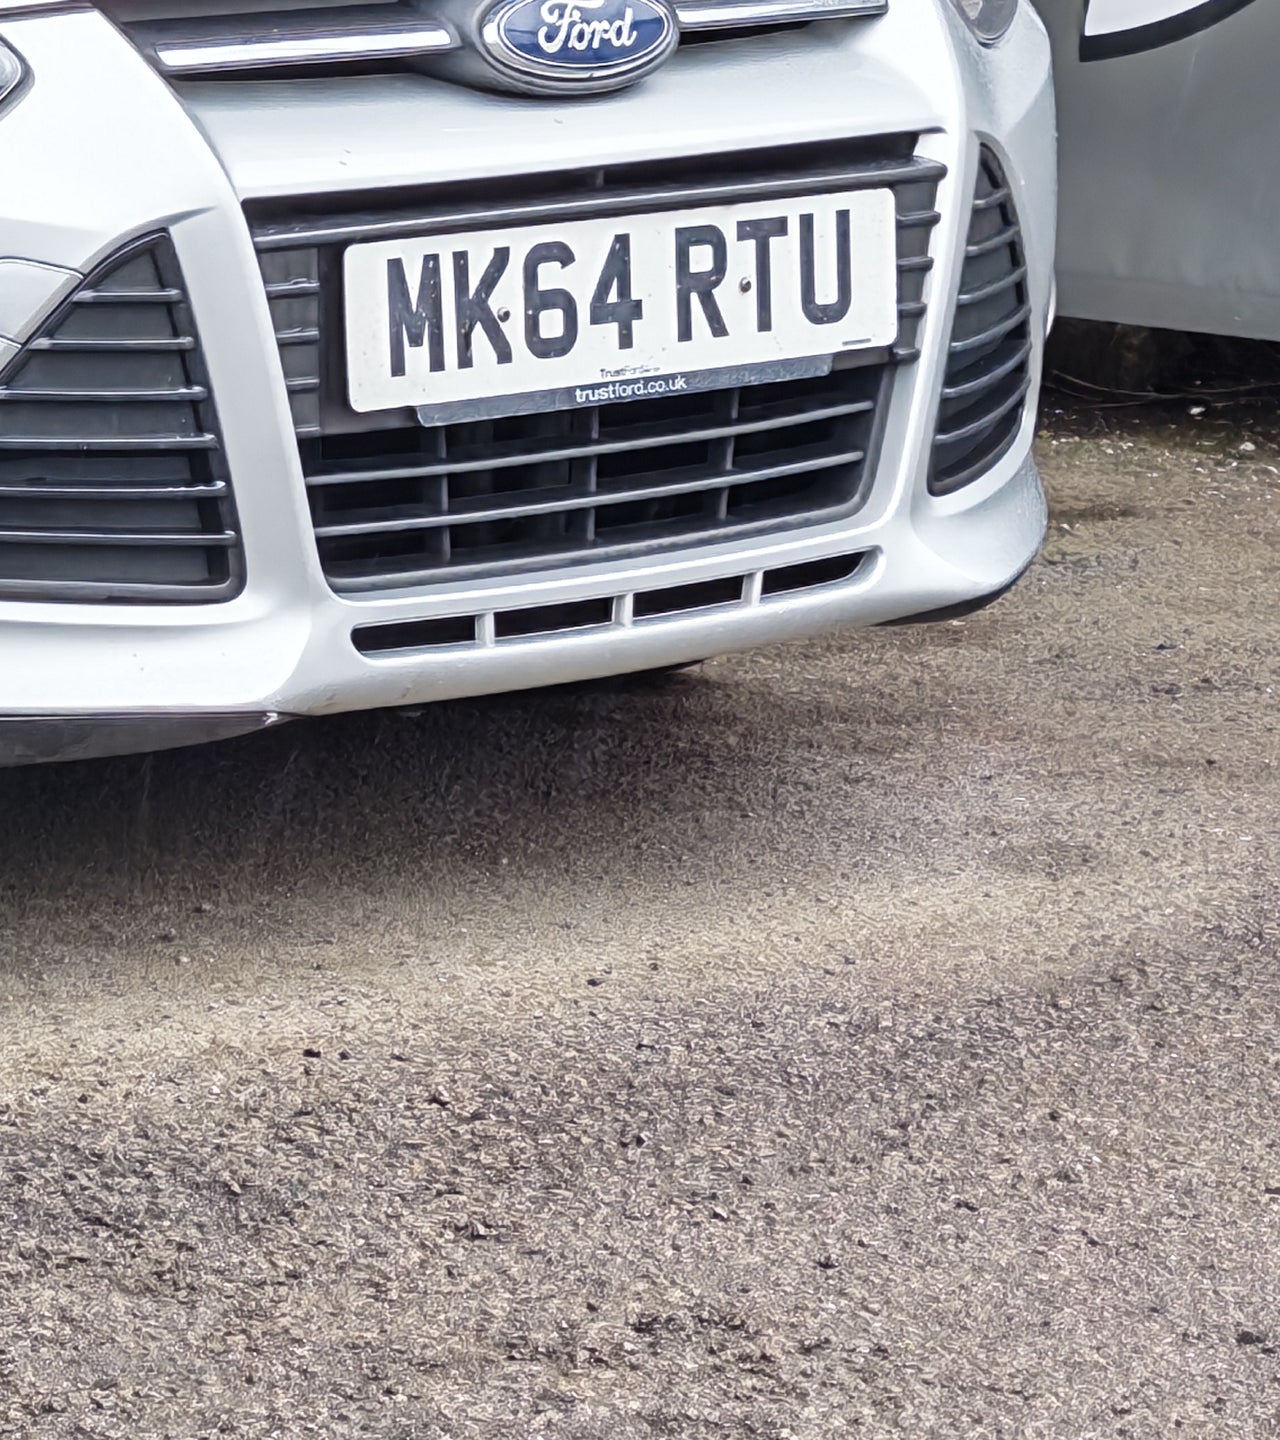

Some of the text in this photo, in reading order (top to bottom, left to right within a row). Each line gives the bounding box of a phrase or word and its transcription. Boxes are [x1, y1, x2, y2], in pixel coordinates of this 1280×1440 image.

[386, 209, 851, 377] MK64 RTU
[575, 374, 687, 402] trustford.co.uk
